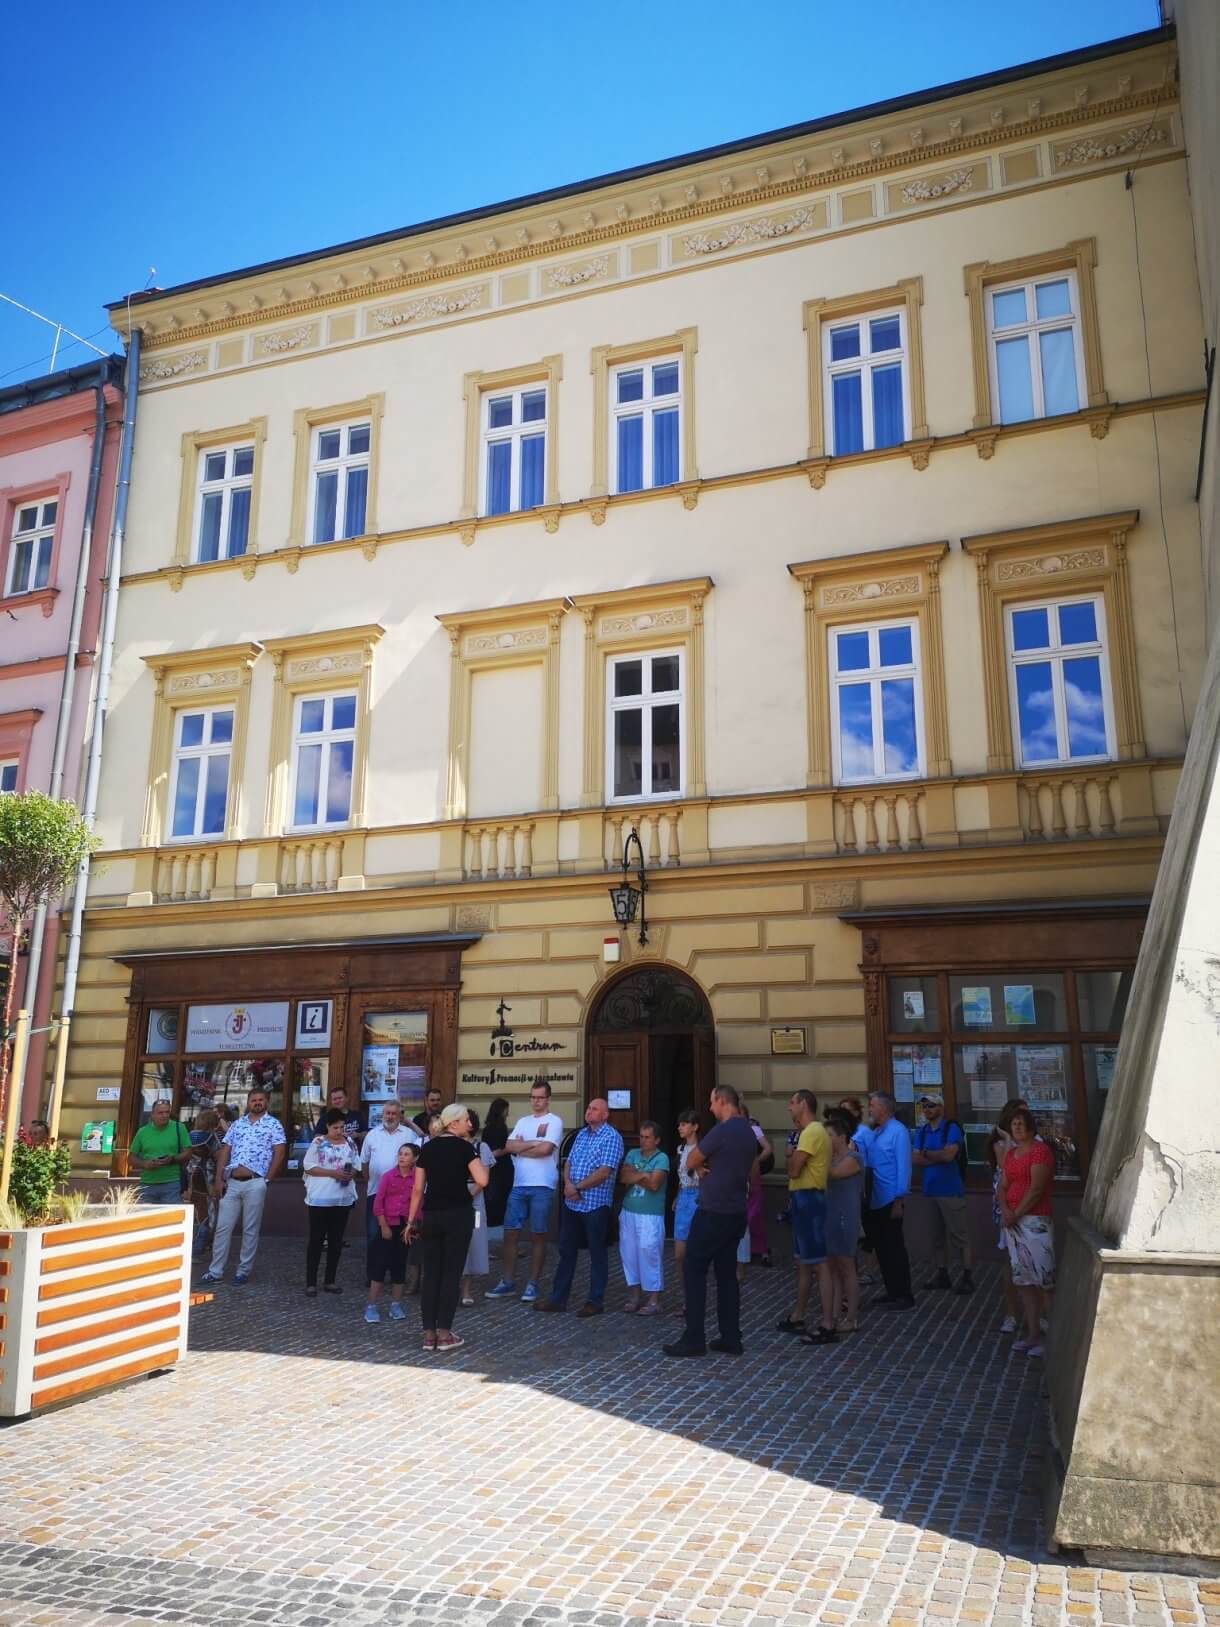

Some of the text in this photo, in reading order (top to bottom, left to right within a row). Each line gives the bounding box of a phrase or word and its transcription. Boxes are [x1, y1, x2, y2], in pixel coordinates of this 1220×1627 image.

[616, 894, 627, 915] 5
[462, 1073, 489, 1084] Kultury
[496, 1073, 526, 1084] Promocji
